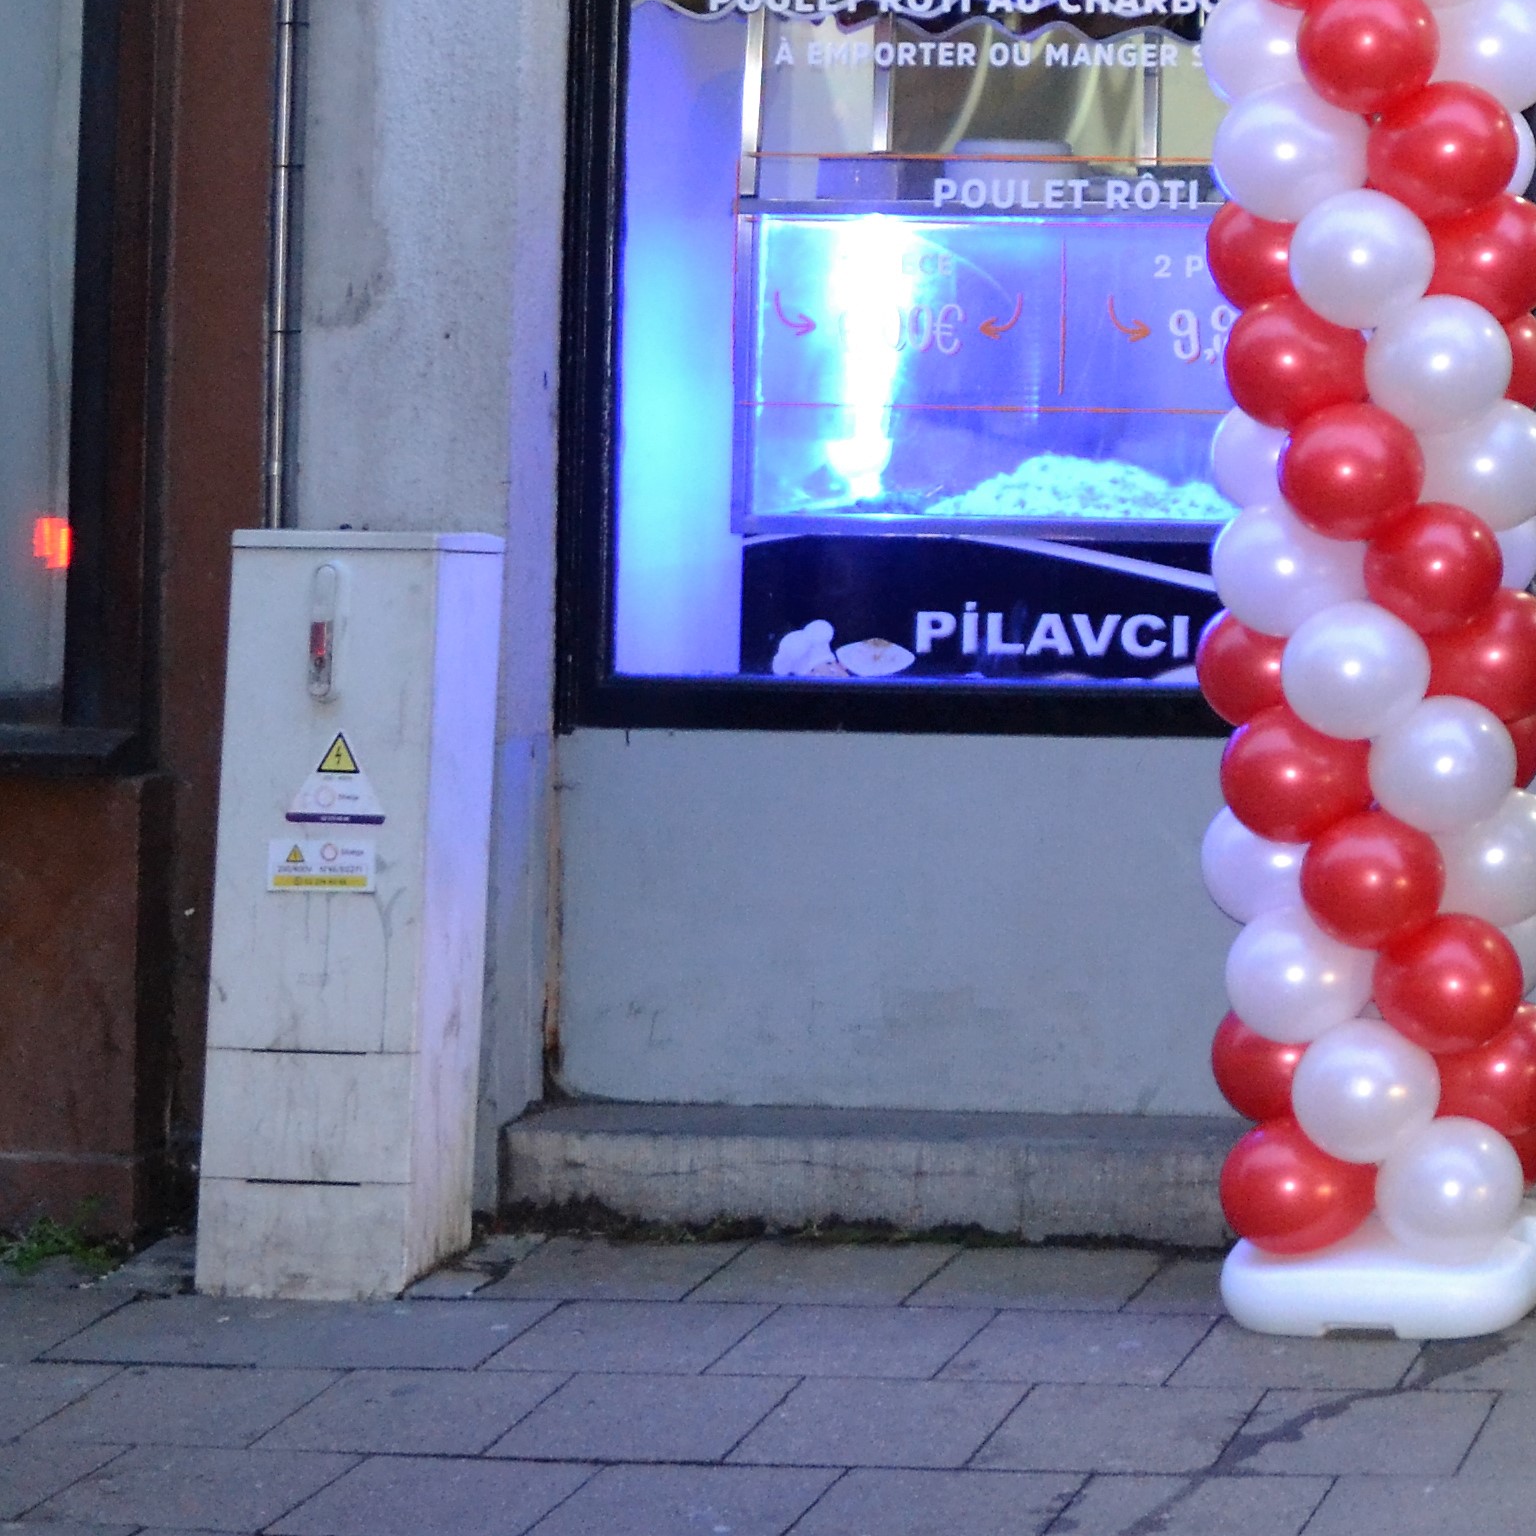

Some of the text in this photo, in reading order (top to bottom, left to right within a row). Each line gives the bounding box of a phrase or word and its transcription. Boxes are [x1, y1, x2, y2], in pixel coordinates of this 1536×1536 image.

[774, 36, 794, 66] À
[806, 41, 978, 68] EMPORTER
[989, 41, 1033, 68] OU
[1045, 43, 1178, 68] MANGER
[933, 172, 1200, 210] POULET RÔTI
[1153, 254, 1172, 278] 2
